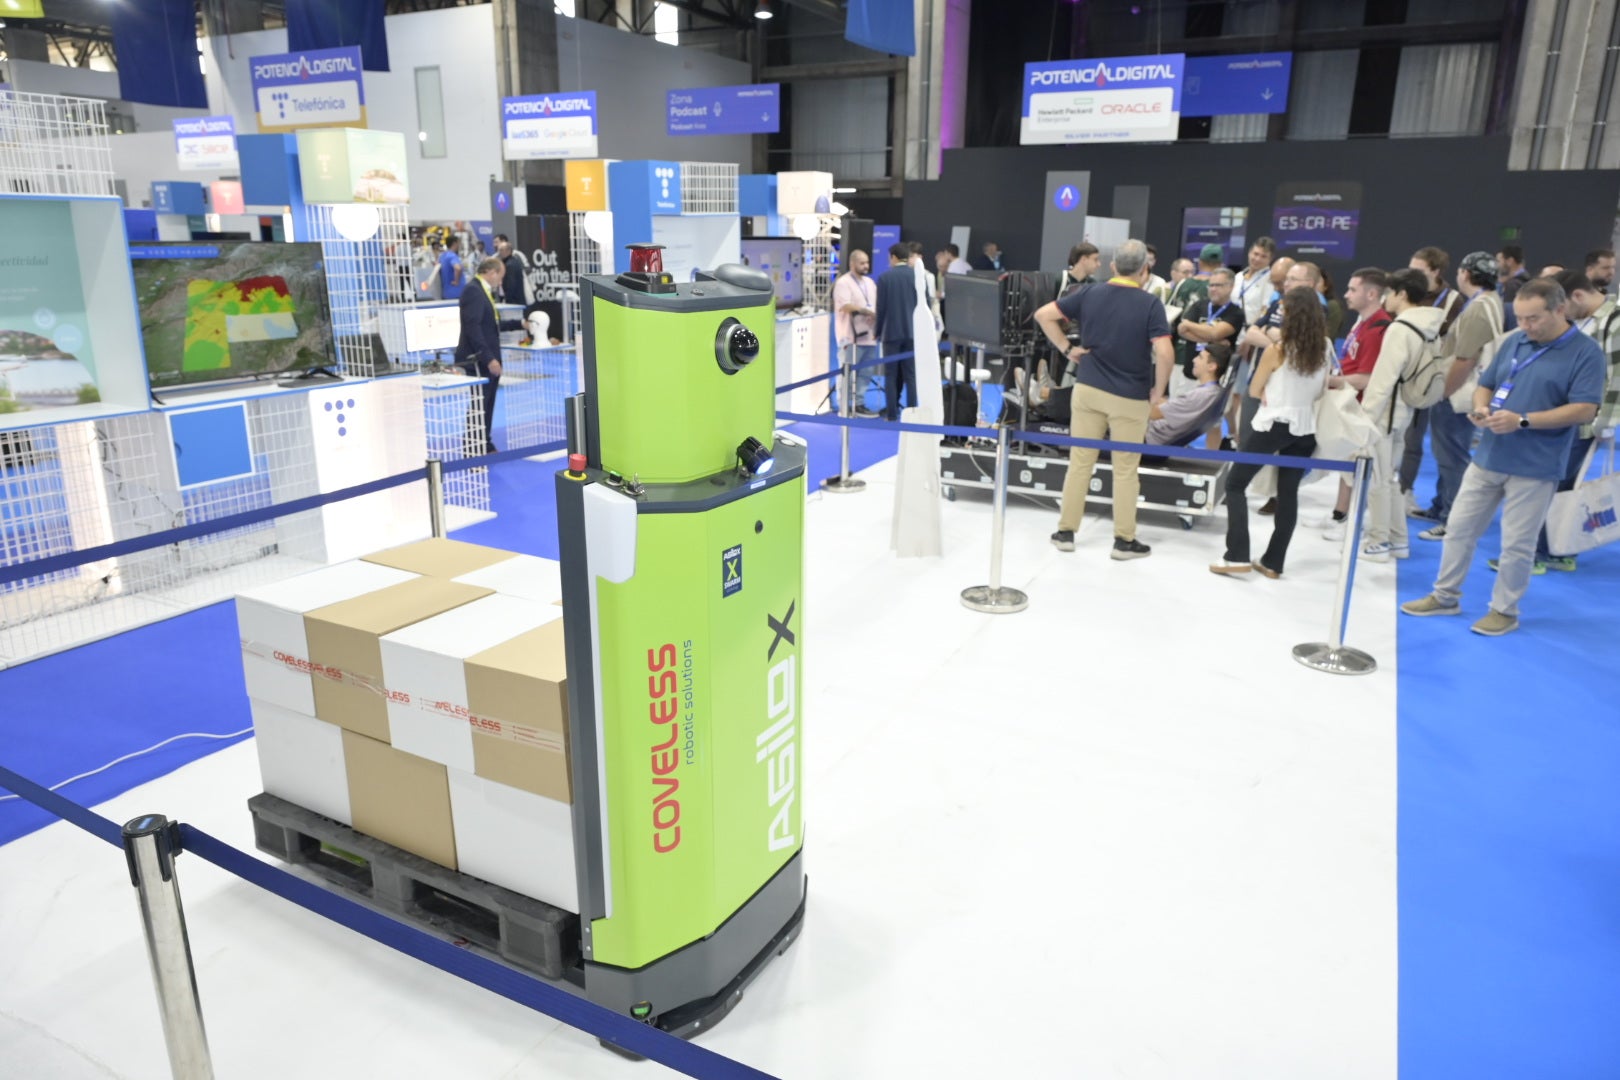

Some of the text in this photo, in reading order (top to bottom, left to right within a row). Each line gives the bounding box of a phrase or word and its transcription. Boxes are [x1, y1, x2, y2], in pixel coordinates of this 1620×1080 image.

[292, 97, 346, 112] Telefónica
[670, 106, 708, 116] Podcast
[1101, 103, 1162, 115] ORACLE
[533, 249, 558, 266] Out
[550, 267, 570, 282] the
[682, 640, 694, 765] robotic solutions
[647, 643, 681, 854] COVELESS
